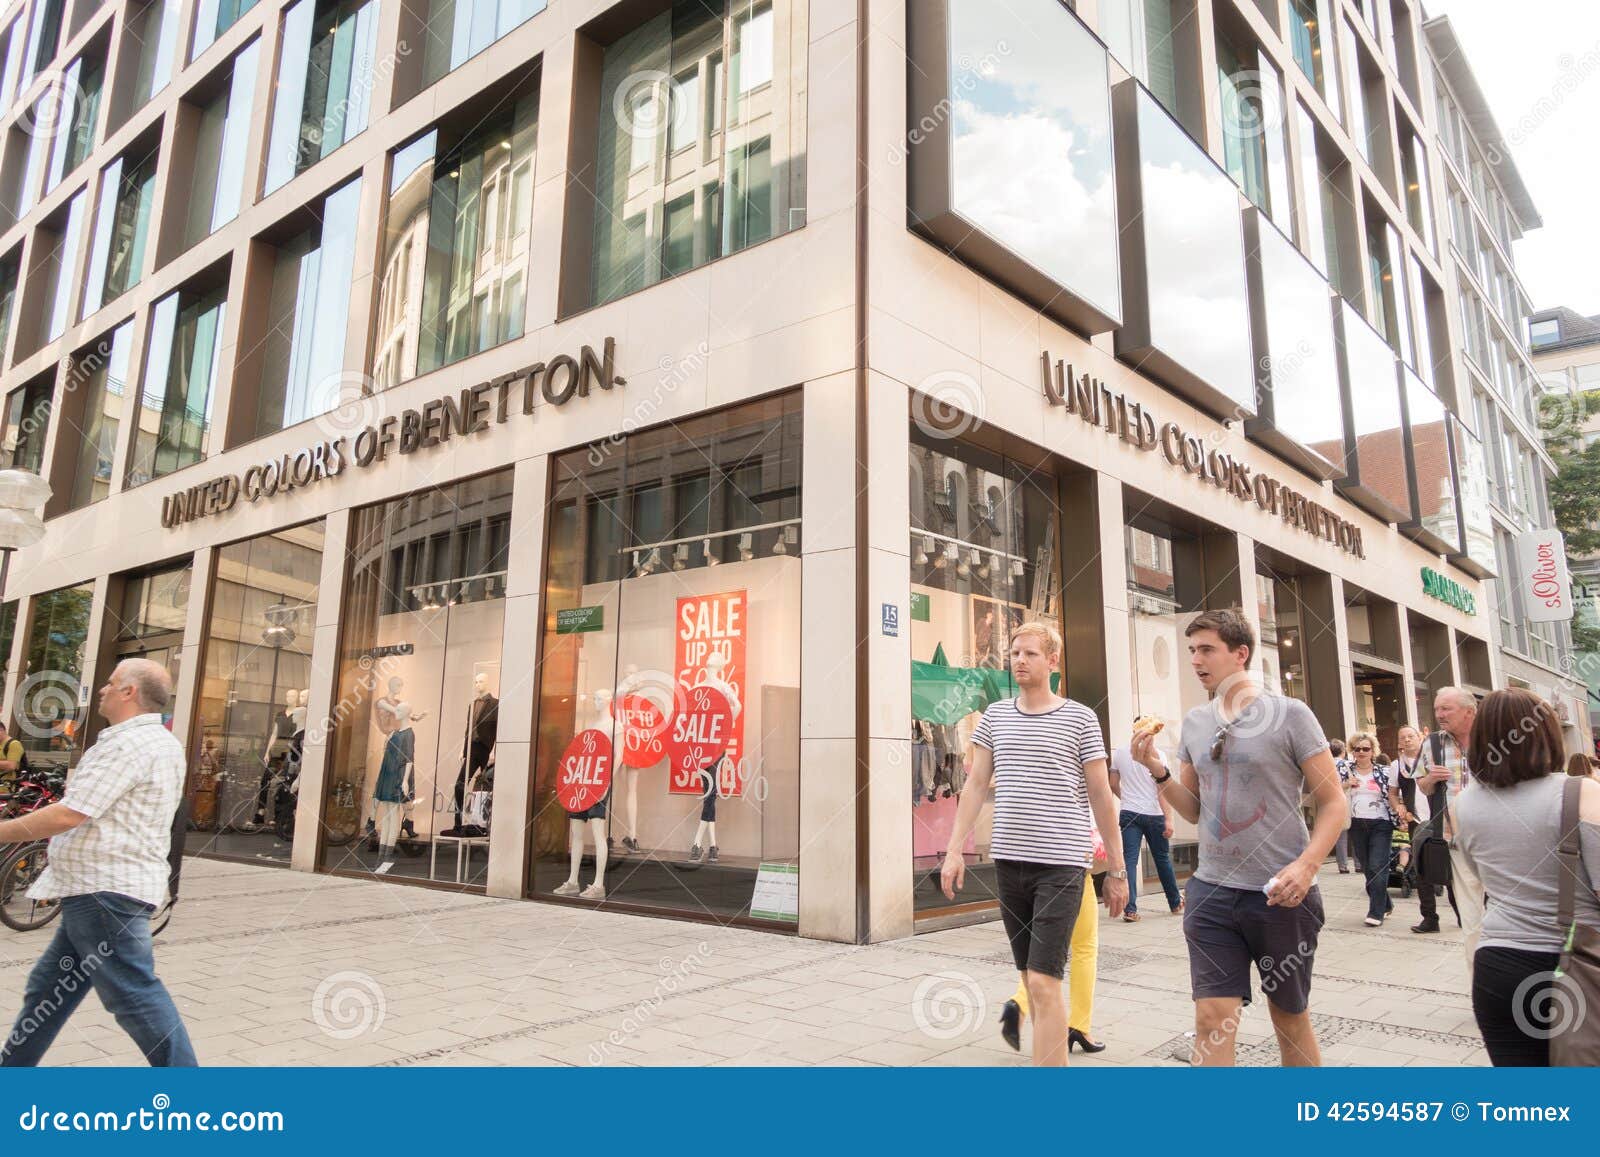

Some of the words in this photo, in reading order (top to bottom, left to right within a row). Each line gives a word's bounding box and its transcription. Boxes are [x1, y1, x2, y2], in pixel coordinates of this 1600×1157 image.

[1040, 350, 1159, 451] UNITED
[1160, 421, 1254, 502] COLORS
[1254, 472, 1281, 515] OF
[161, 473, 240, 529] UNITED
[242, 436, 347, 503] COLORS
[353, 415, 397, 468] OF
[1531, 541, 1562, 609] s.Oliver
[680, 598, 741, 641] SALE
[884, 606, 897, 621] 15
[686, 641, 707, 666] UP
[637, 710, 654, 728] TO
[673, 713, 724, 744] SALE
[563, 756, 607, 785] SALE
